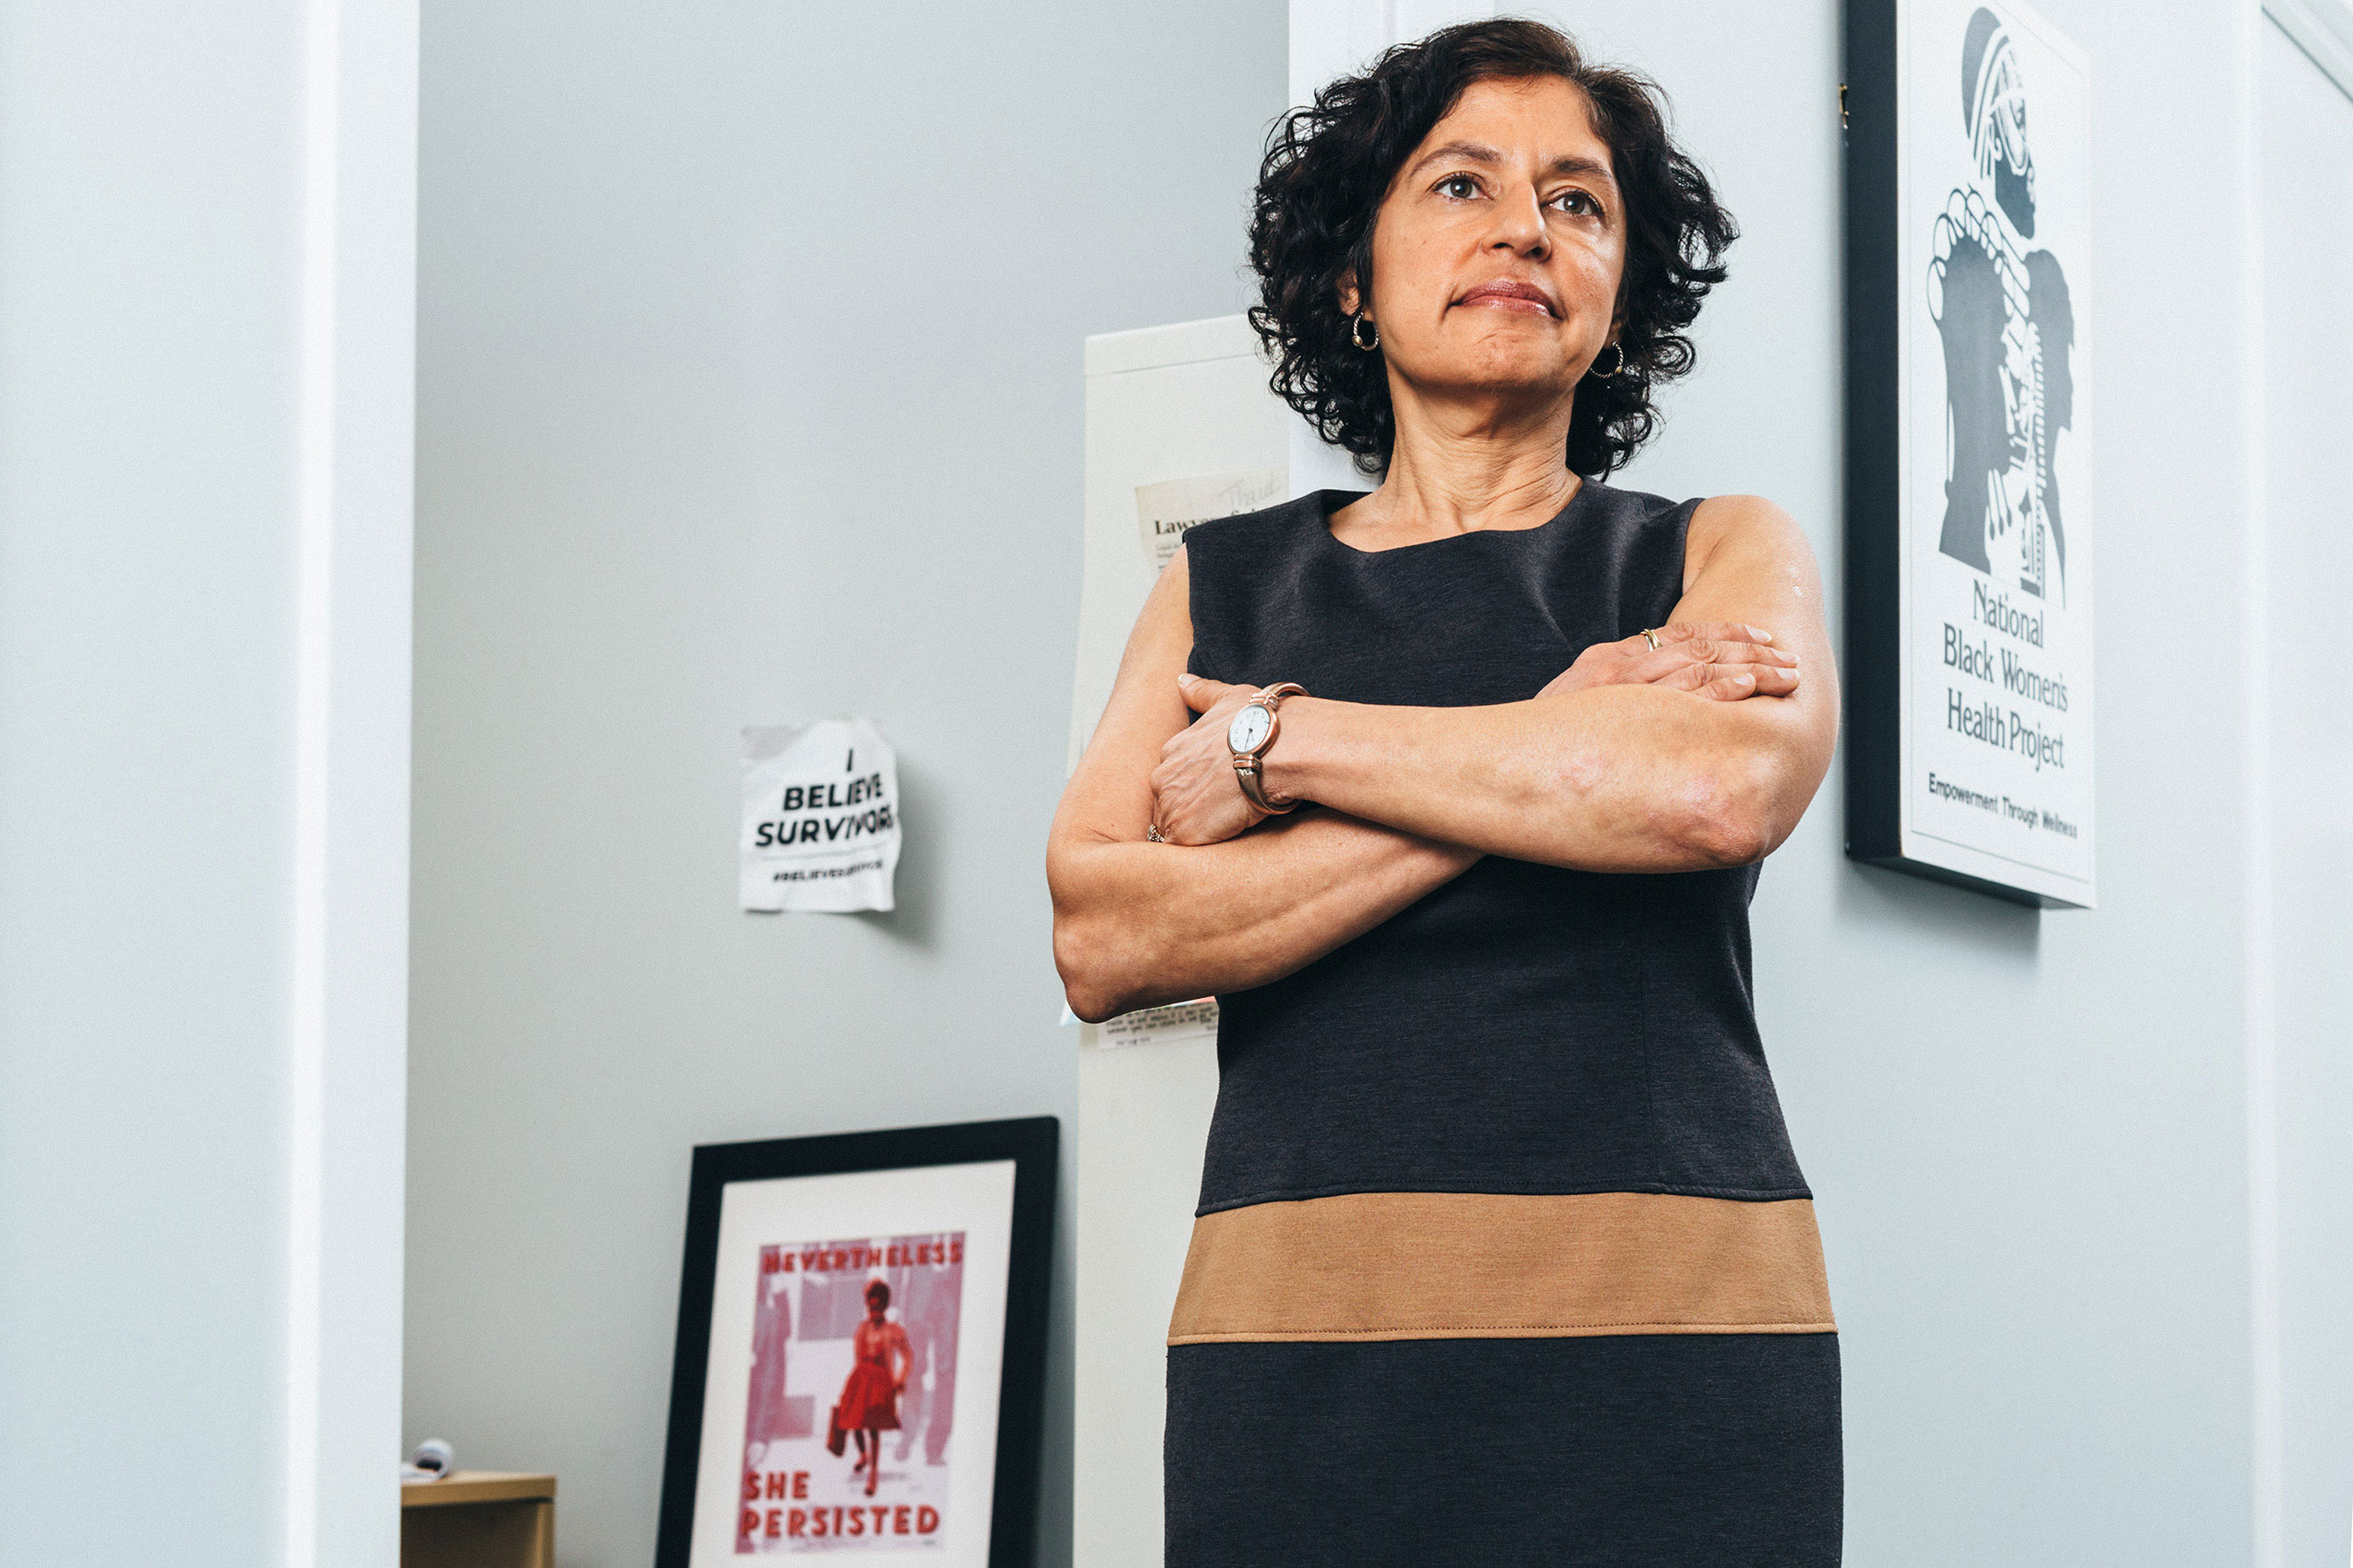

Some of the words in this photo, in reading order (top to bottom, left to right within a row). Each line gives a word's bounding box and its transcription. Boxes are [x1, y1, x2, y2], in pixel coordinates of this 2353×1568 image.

[1973, 578, 2043, 648] National
[1944, 622, 1994, 684] Black
[2000, 647, 2068, 712] Women's
[1947, 687, 2006, 748] Health
[2009, 711, 2064, 772] Project
[846, 748, 853, 772] I
[783, 772, 883, 812] BELIEVE
[1929, 772, 1999, 815] Empowerment
[2001, 796, 2040, 829] Through
[2042, 809, 2078, 839] Wellness
[762, 1240, 963, 1274] NEVERTHELESS
[743, 1470, 810, 1501] SHE
[740, 1504, 940, 1539] PERSISTED
